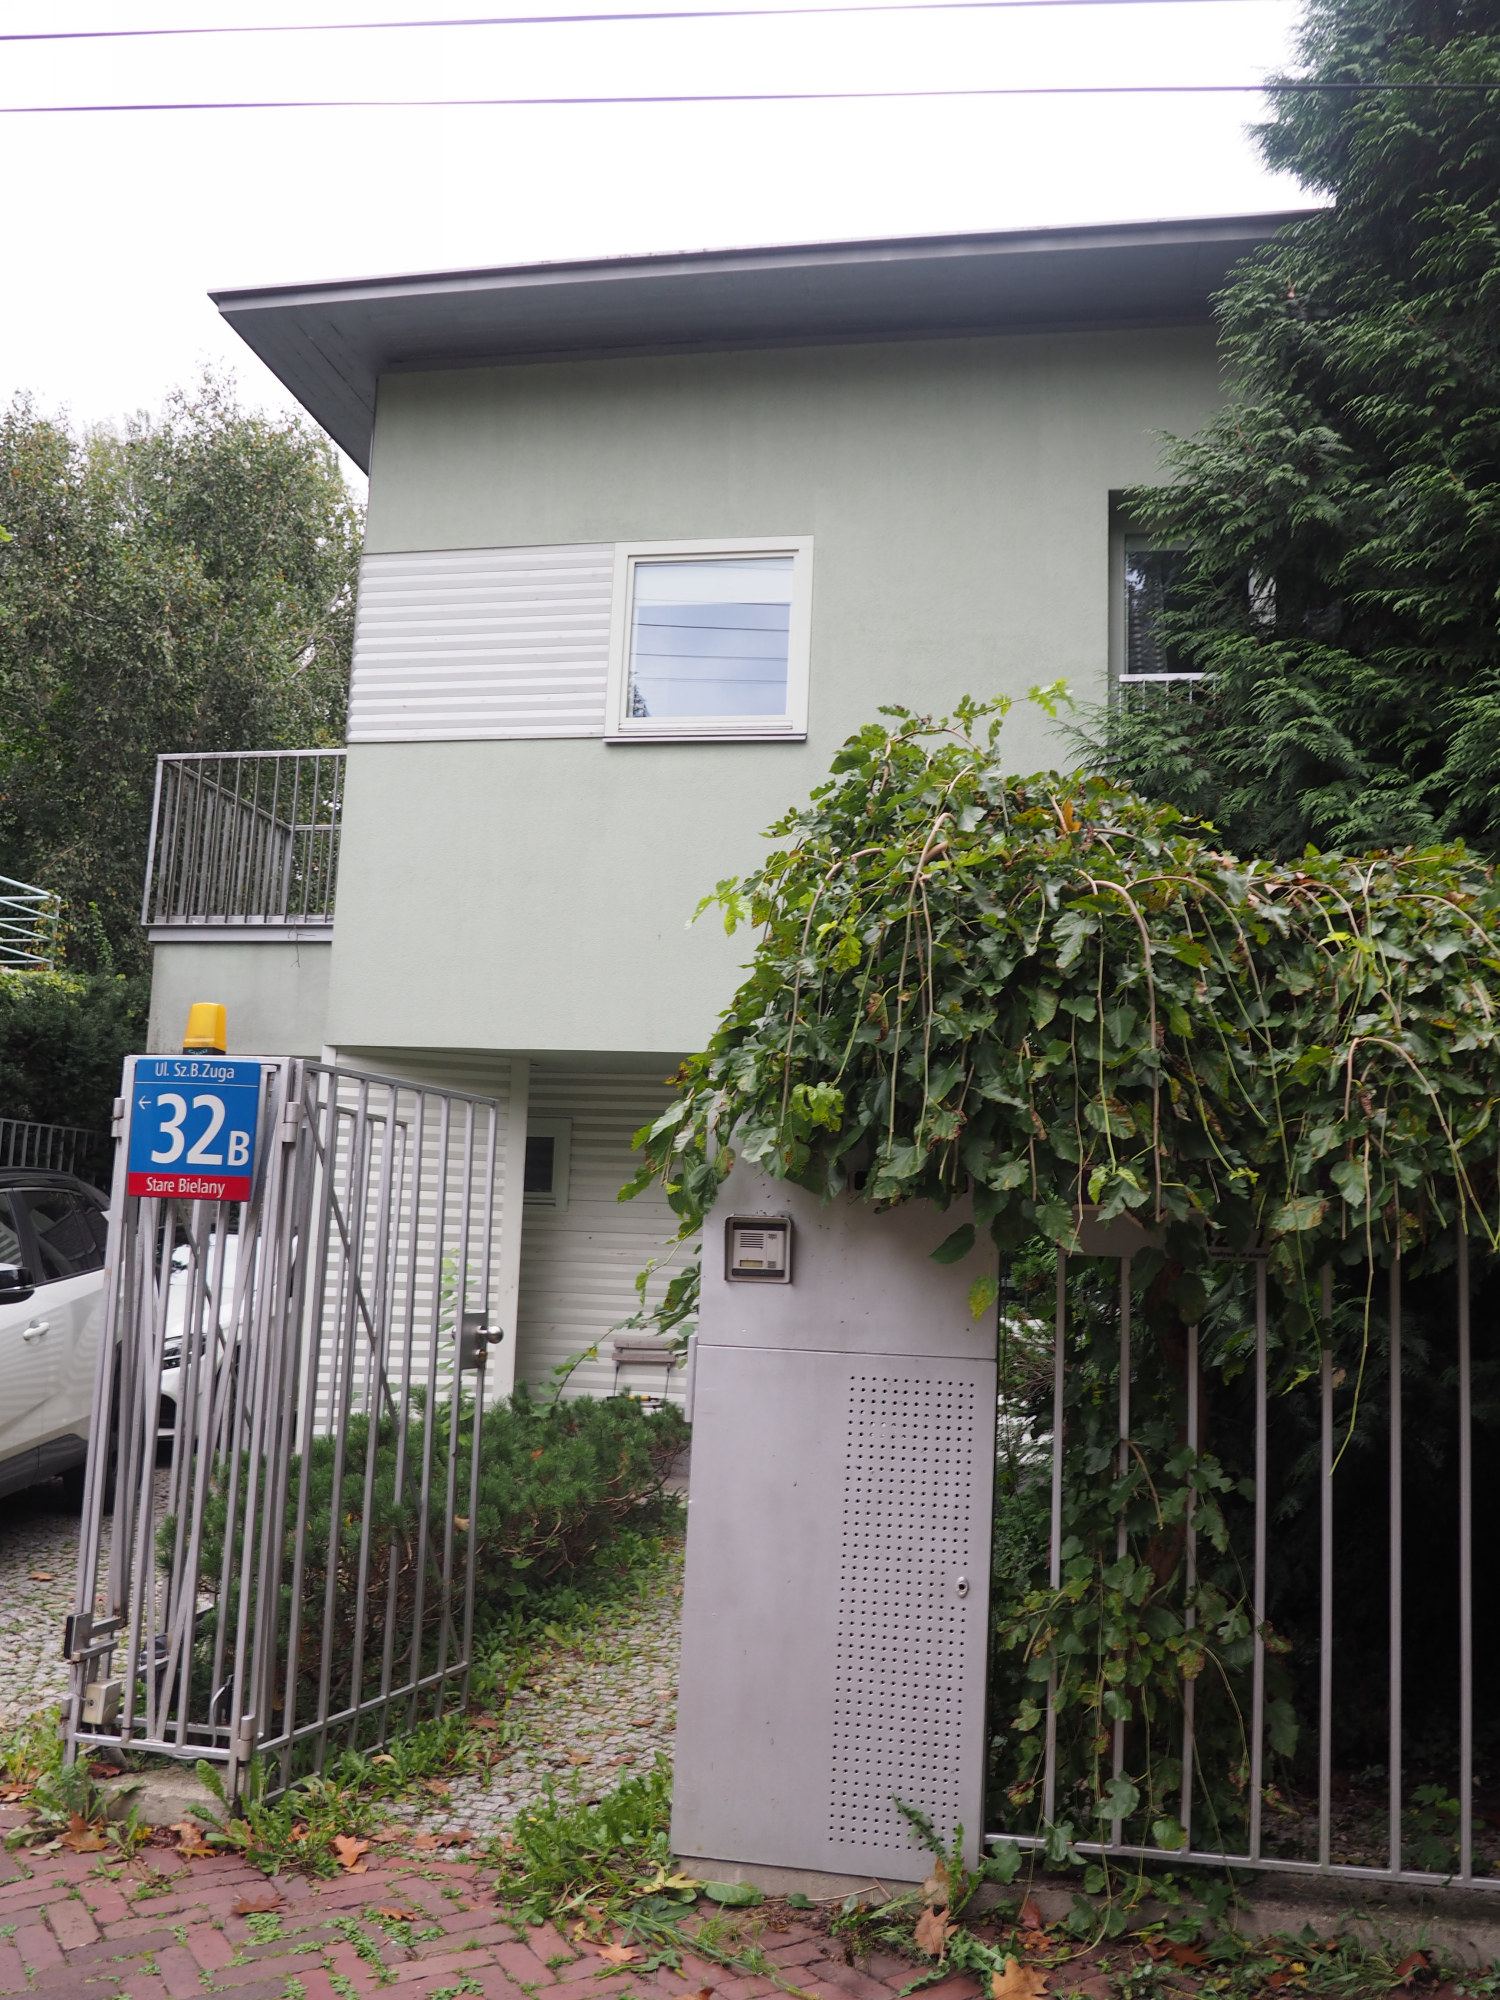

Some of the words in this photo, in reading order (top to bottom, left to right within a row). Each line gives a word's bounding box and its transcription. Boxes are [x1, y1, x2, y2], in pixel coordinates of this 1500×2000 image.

[154, 1062, 170, 1077] Ul.
[145, 1177, 175, 1193] Stare
[178, 1178, 226, 1198] Bielany
